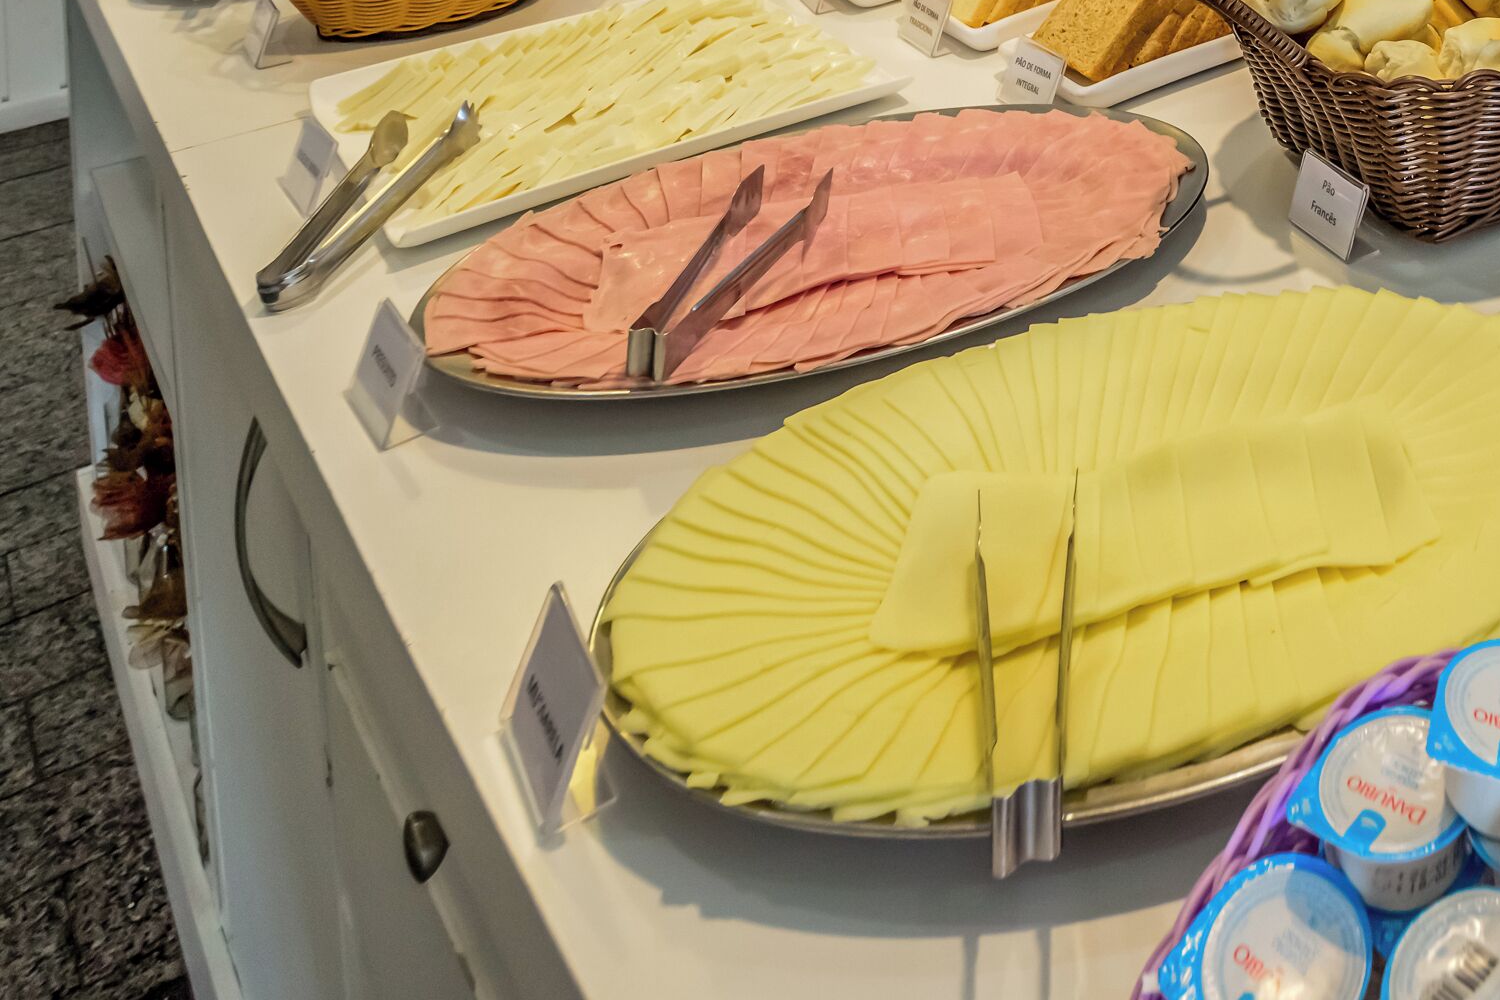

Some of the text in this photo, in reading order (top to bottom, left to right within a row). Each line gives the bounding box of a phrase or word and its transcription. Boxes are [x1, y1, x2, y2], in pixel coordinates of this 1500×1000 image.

[1034, 65, 1051, 80] FORMA
[1016, 78, 1039, 95] INTEGRAL
[1322, 180, 1335, 196] Pão
[1310, 200, 1337, 226] Francês
[1347, 775, 1427, 826] DANUBIO
